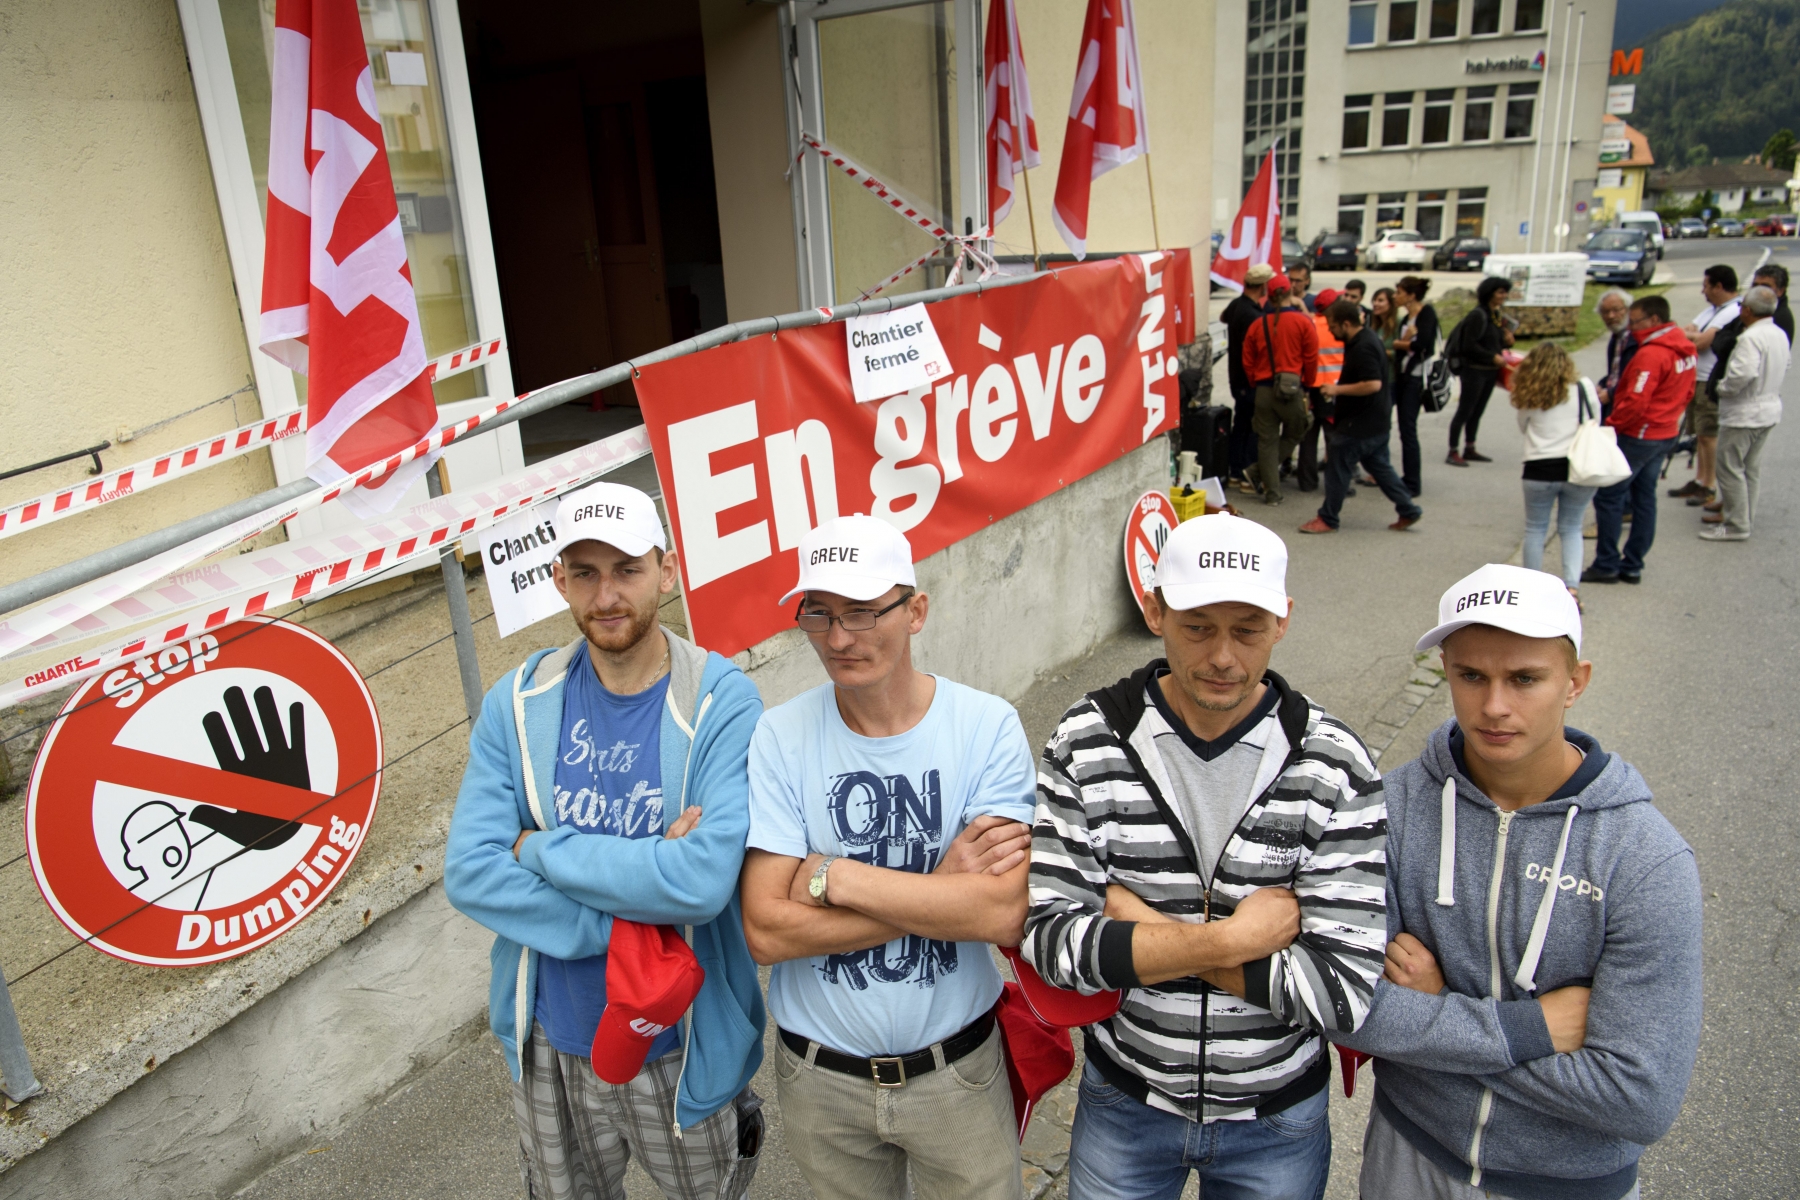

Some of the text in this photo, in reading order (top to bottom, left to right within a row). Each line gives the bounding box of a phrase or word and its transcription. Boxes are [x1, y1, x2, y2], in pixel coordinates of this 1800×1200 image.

[1465, 55, 1529, 74] helvetia
[852, 321, 924, 348] Chantier
[864, 345, 920, 373] fermé
[271, 426, 300, 442] CHARTE
[667, 322, 1106, 592] En grève
[98, 486, 134, 504] CHARTE
[1140, 496, 1161, 515] Stop
[574, 504, 625, 523] GREVE
[489, 521, 557, 566] Chanti
[810, 547, 859, 565] GREVE
[1198, 551, 1260, 572] GREVE
[511, 562, 553, 594] ferm
[1456, 590, 1520, 613] GREVE
[24, 656, 84, 688] CHARTE
[102, 634, 219, 709] Stop
[826, 768, 943, 848] ON
[176, 814, 362, 951] Dumping
[1525, 862, 1604, 902] CROPP
